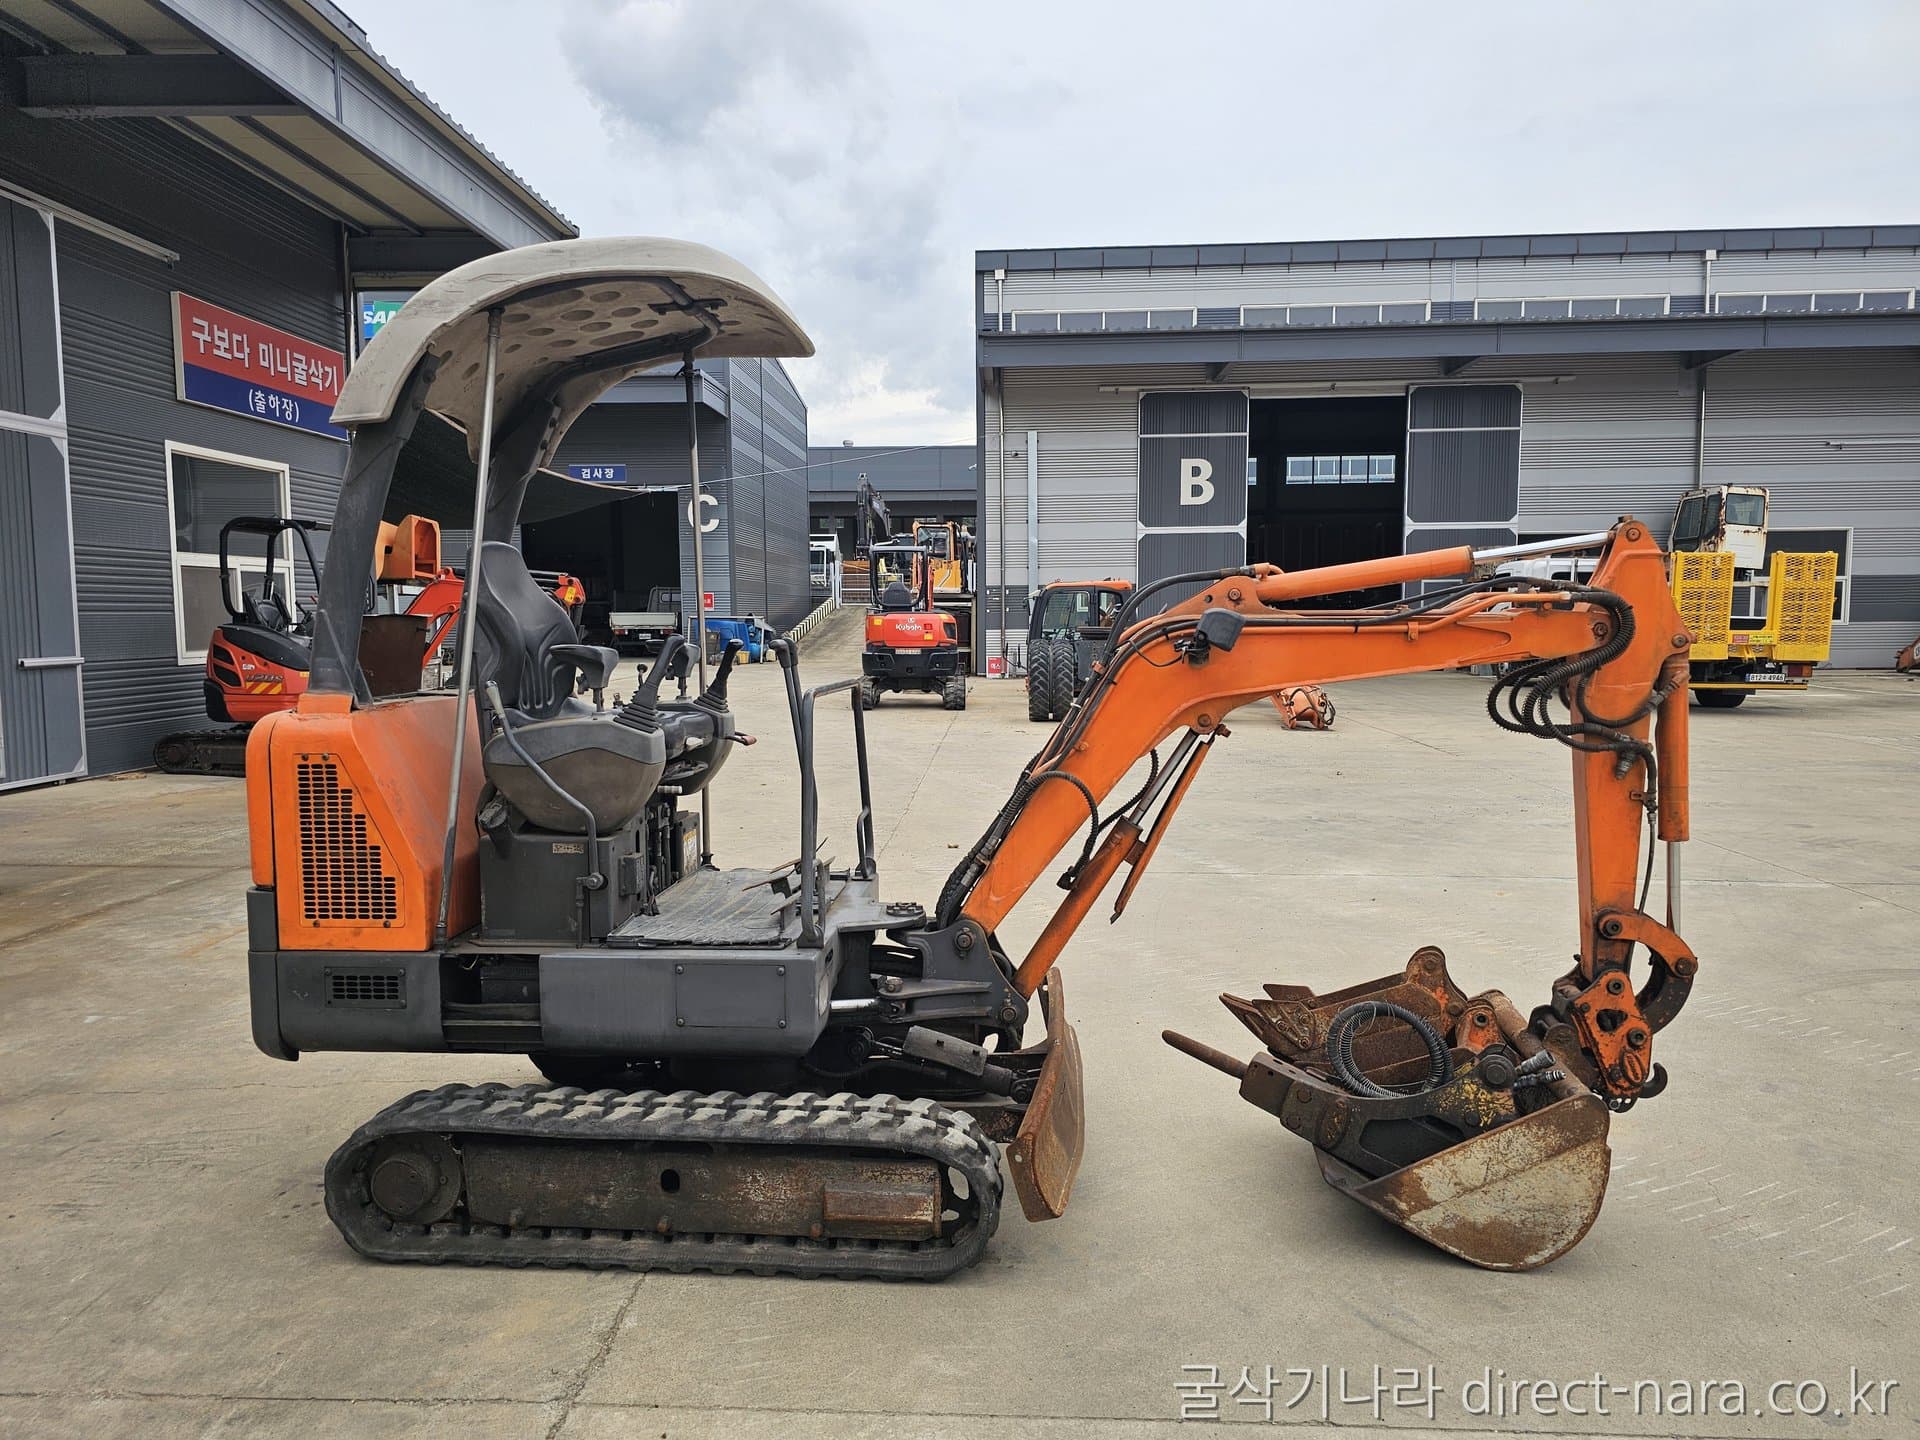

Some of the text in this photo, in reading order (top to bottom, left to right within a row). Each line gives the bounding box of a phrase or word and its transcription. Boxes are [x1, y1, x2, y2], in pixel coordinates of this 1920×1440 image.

[191, 316, 339, 397] 구보다 미니굴삭기
[248, 388, 300, 423] (출하장)
[581, 468, 615, 479] 검사장
[1180, 458, 1215, 506] B
[687, 494, 720, 533] C
[895, 623, 922, 631] Kubota
